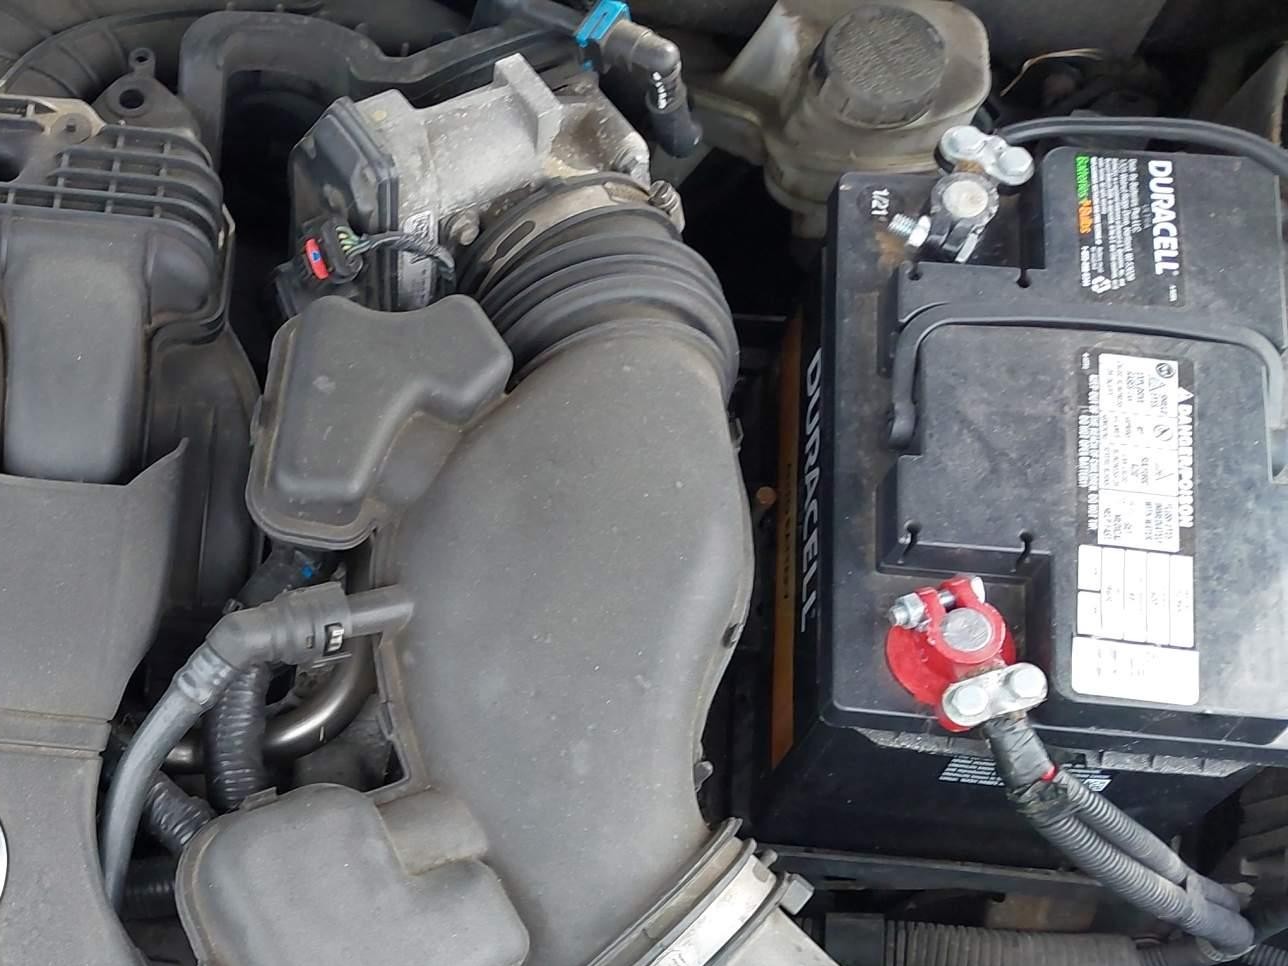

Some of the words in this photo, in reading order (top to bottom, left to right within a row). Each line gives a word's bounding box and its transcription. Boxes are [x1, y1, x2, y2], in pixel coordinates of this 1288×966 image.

[871, 188, 890, 215] 1/21
[1148, 160, 1180, 275] DURACELL
[801, 347, 822, 633] DURACELL
[1178, 403, 1194, 528] DANGER/POISON
